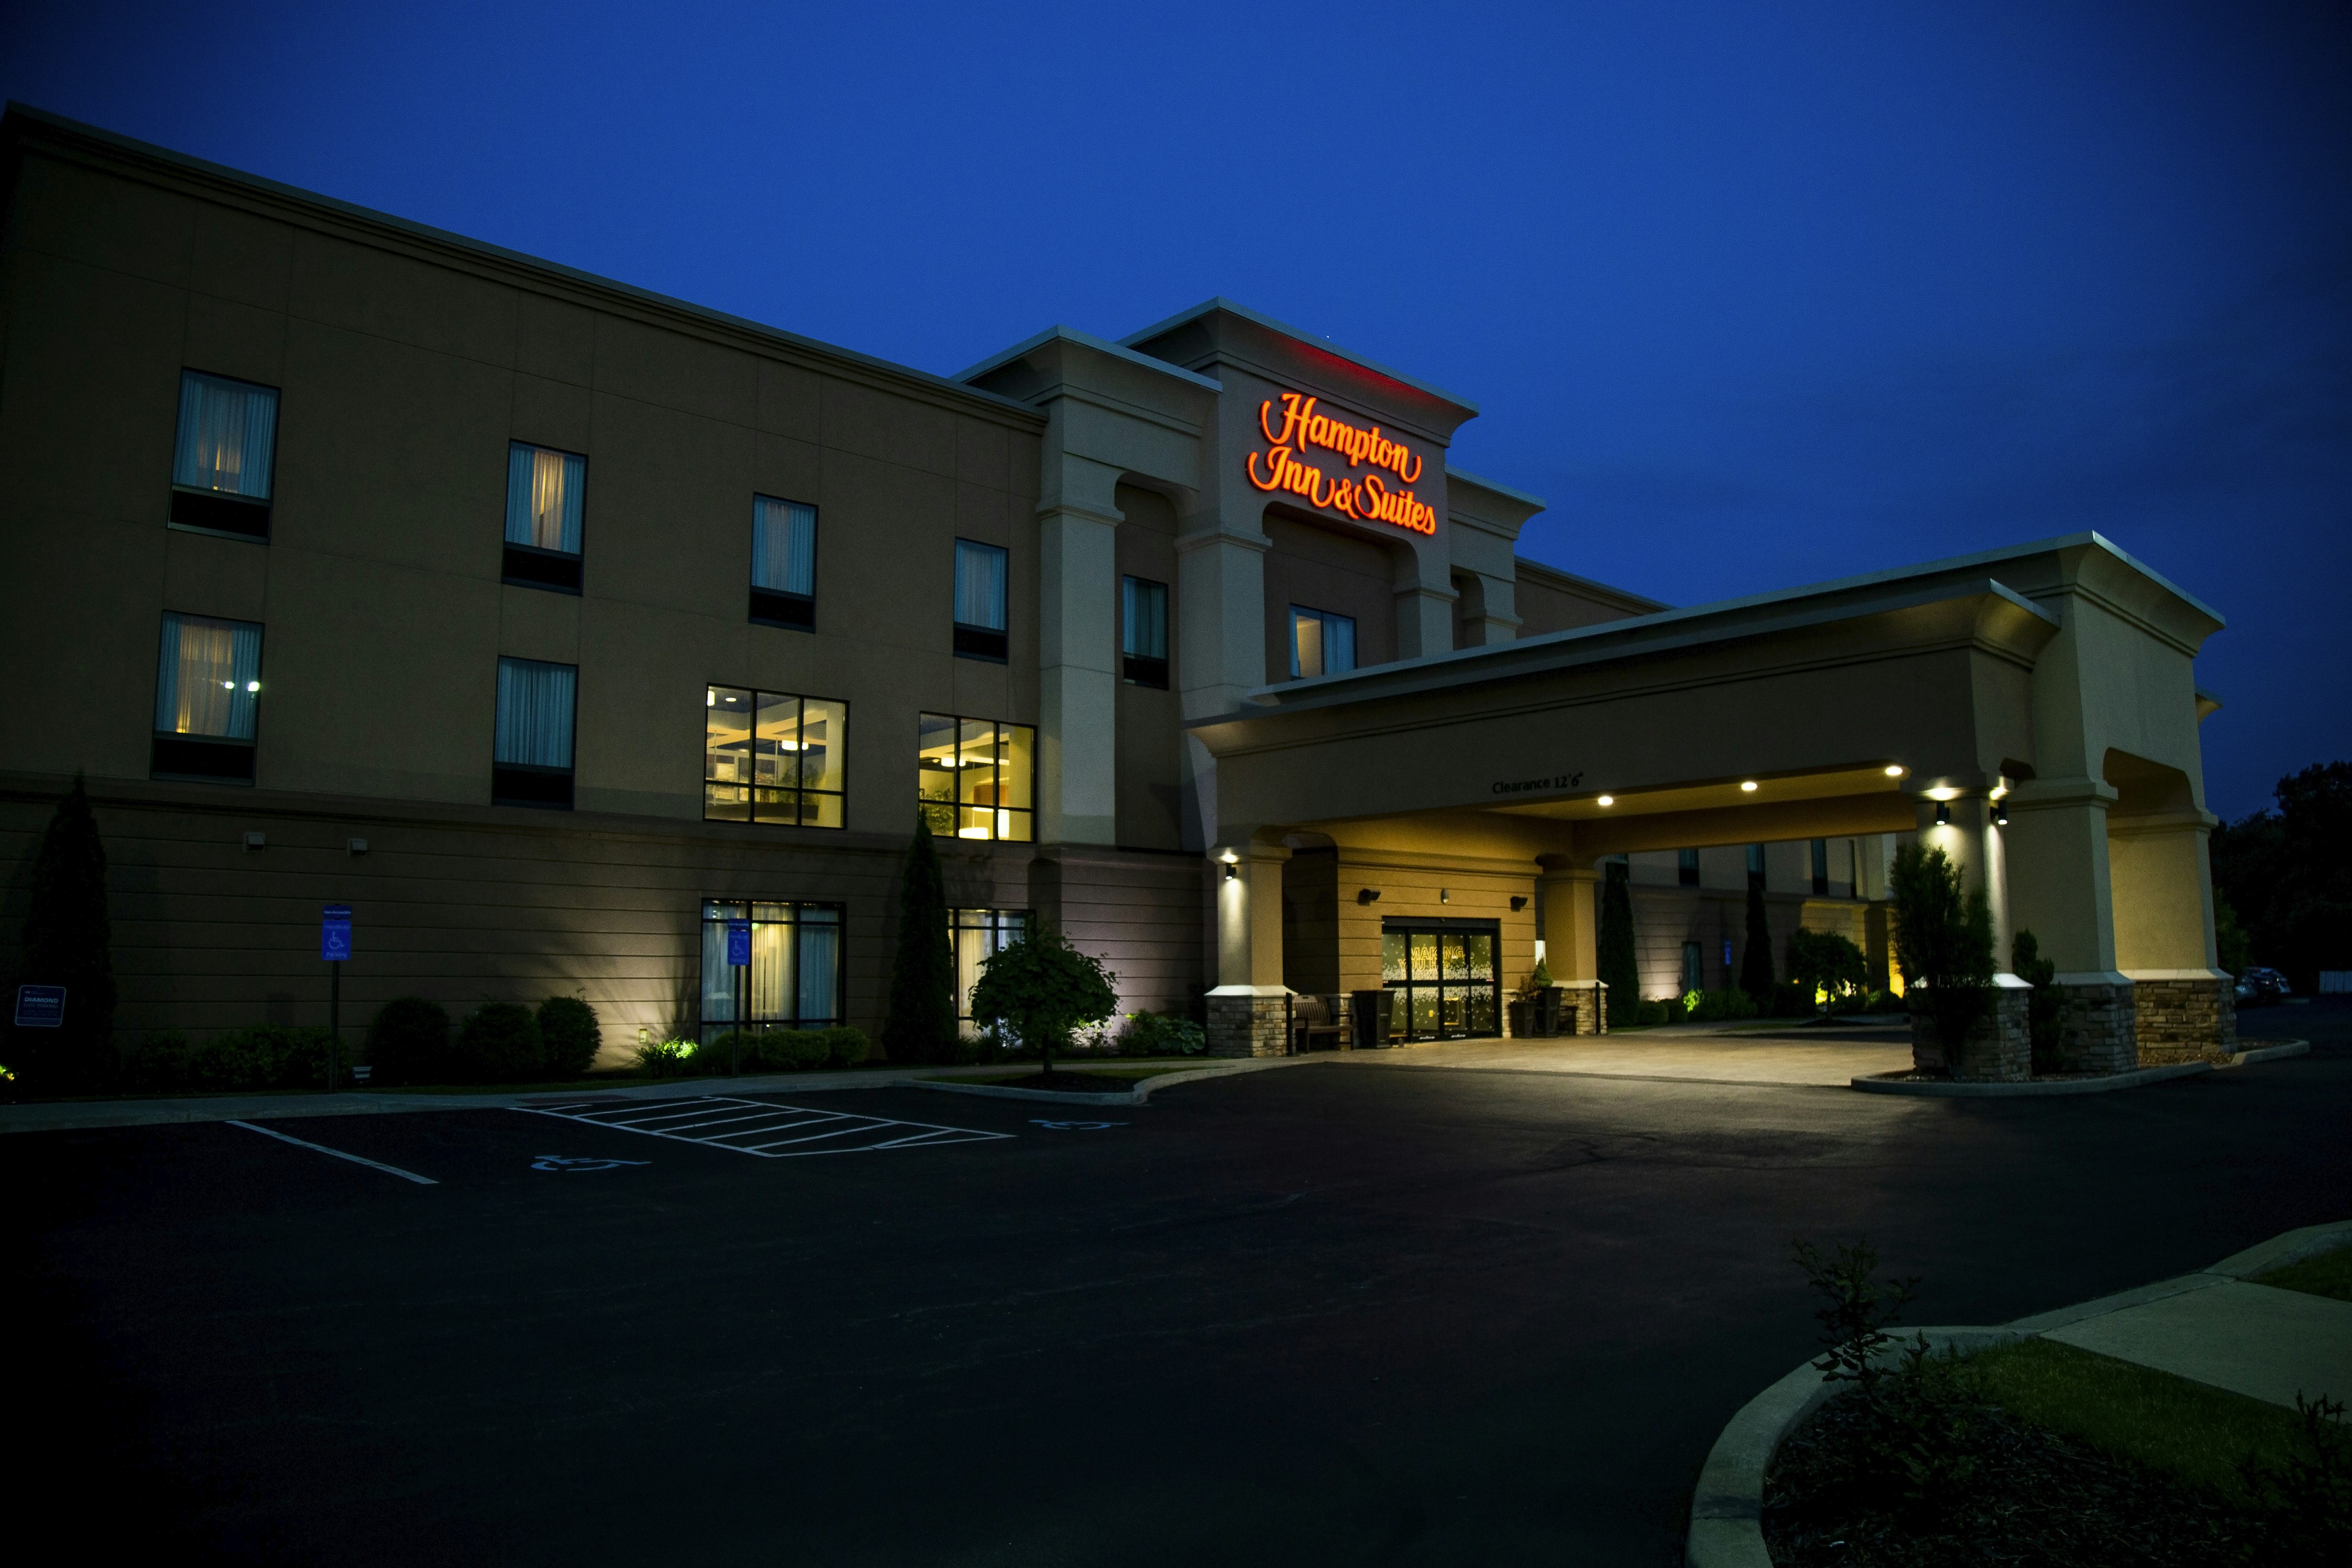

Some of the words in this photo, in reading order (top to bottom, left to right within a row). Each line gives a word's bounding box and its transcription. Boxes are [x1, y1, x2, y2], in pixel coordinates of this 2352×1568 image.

[1260, 392, 1422, 483] Hampton
[1247, 445, 1335, 508] Inn
[1334, 478, 1359, 520] &
[1354, 474, 1436, 535] Suites
[1492, 778, 1550, 794] Clearance
[1411, 946, 1464, 960] MAKNG
